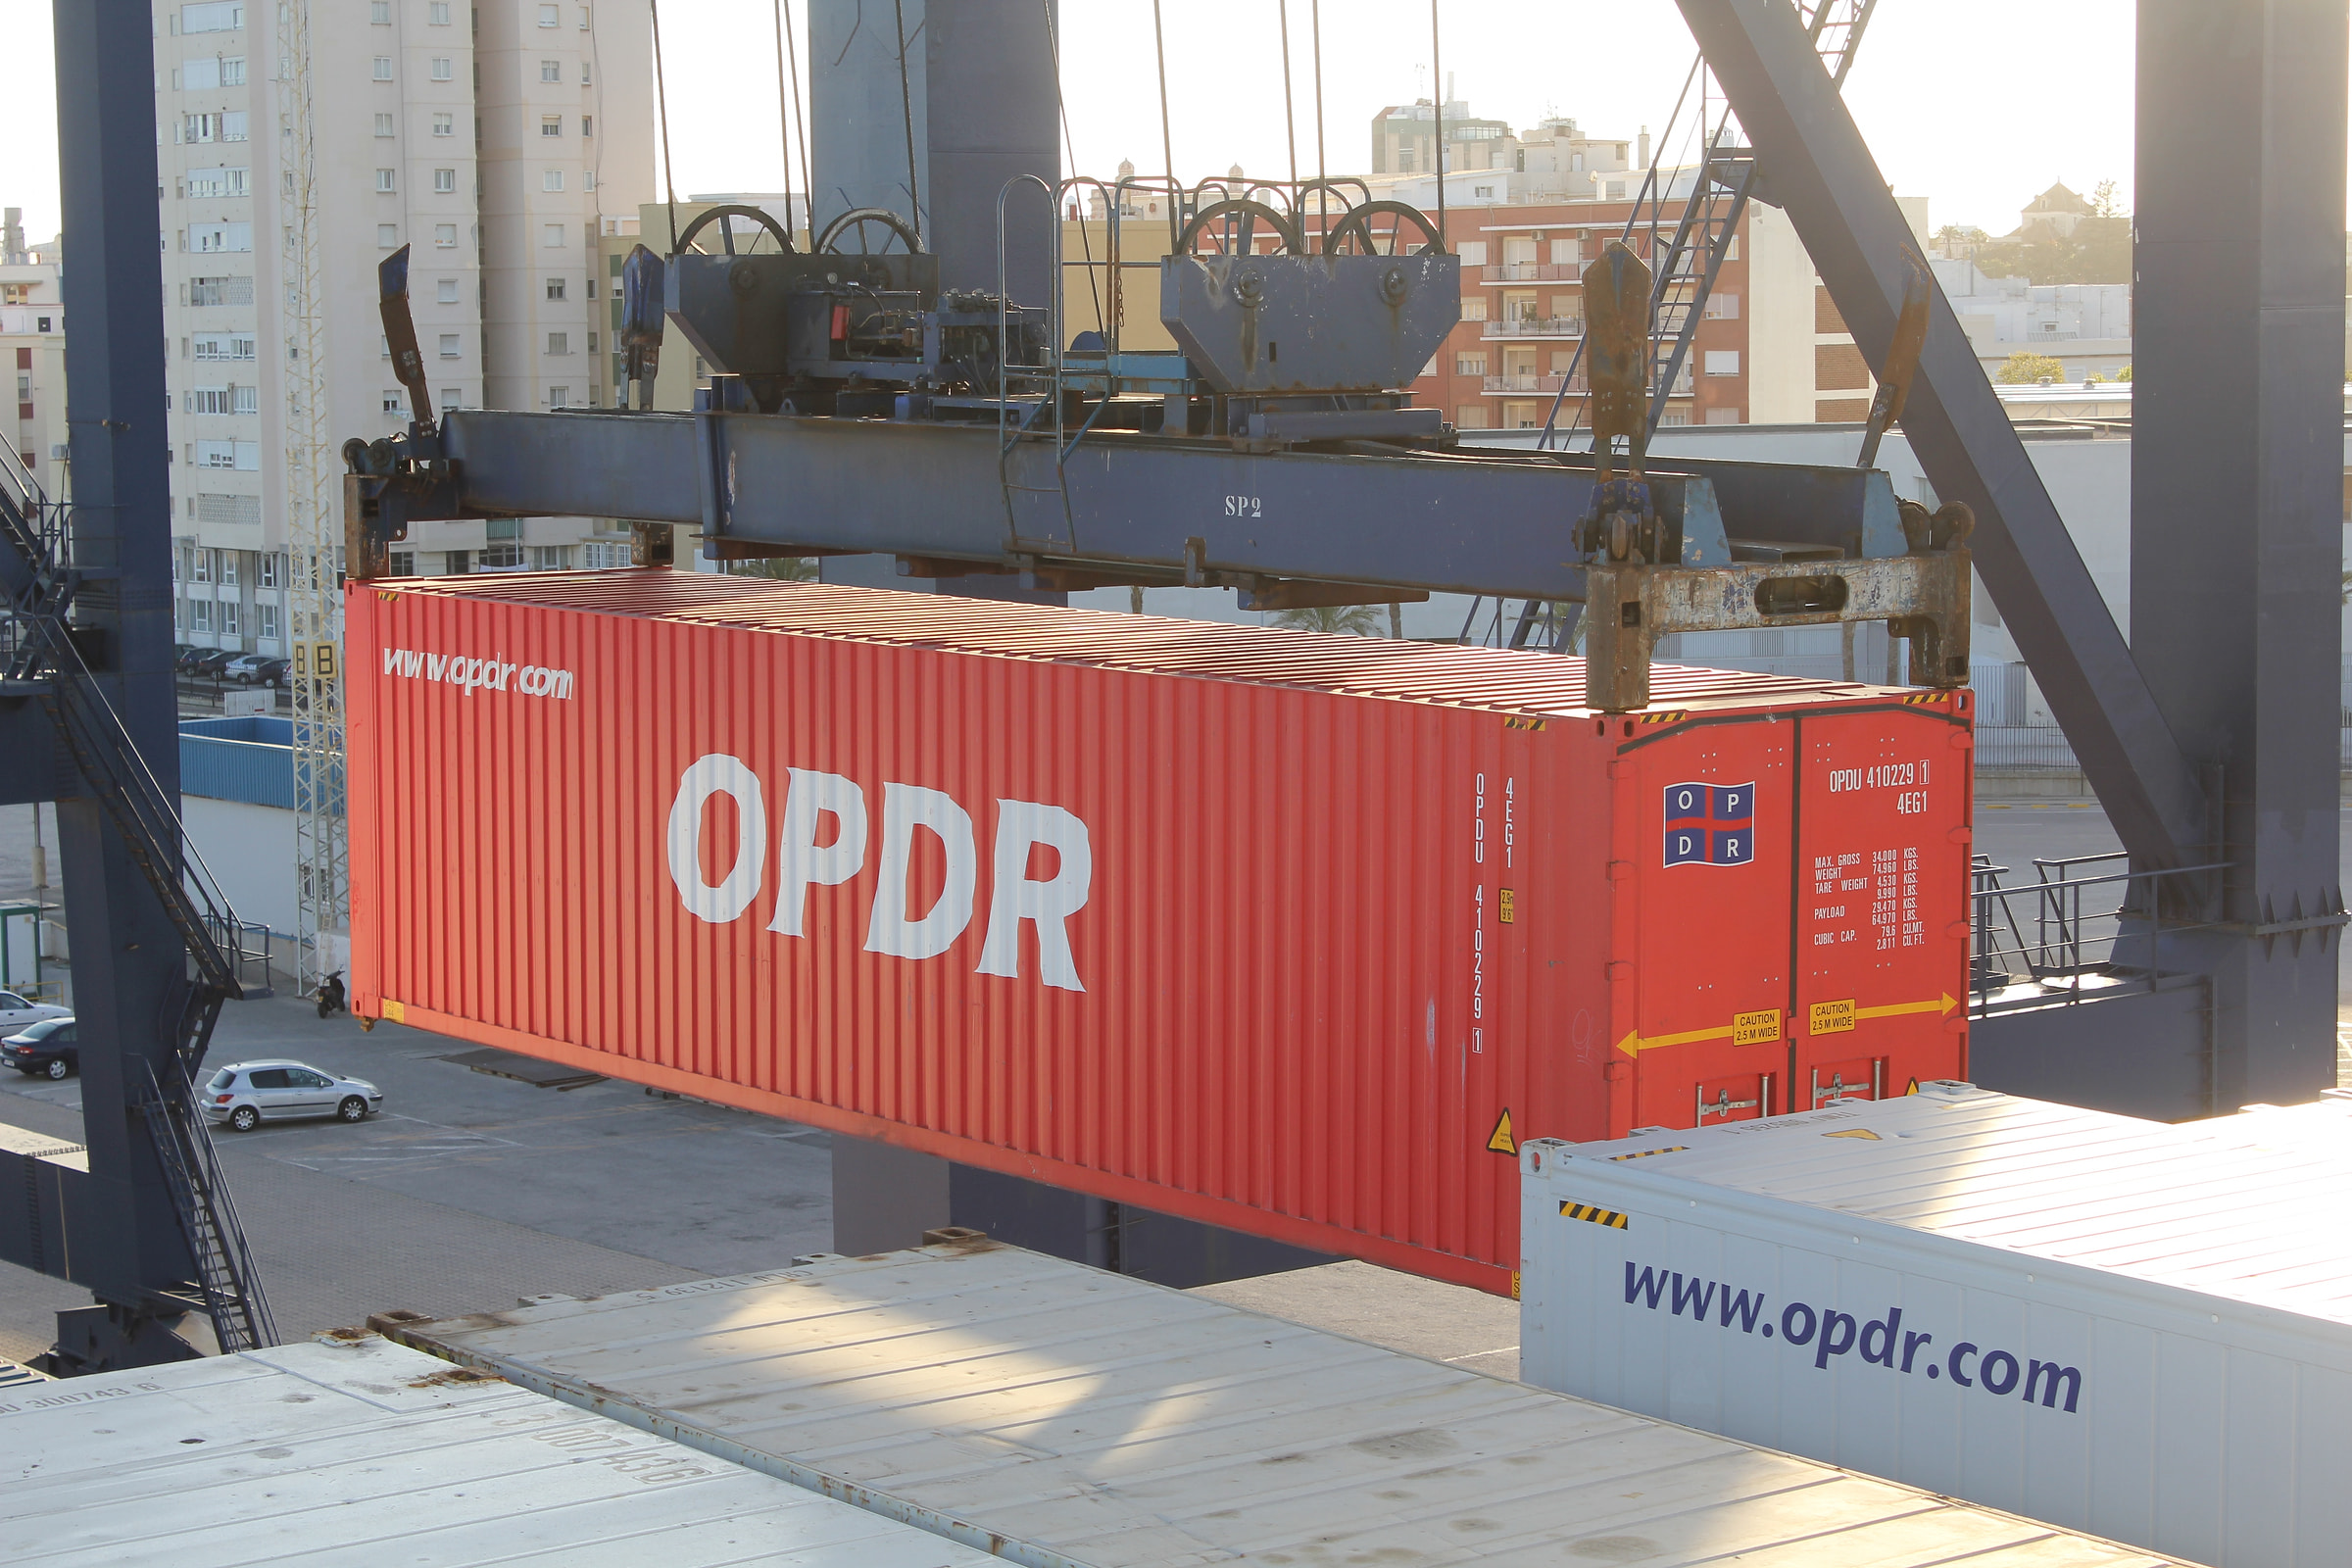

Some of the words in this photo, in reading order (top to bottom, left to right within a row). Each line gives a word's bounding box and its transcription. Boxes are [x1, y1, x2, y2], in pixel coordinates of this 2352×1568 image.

[1225, 495, 1261, 517] SP2
[383, 647, 573, 700] www.opdr.com
[1830, 768, 1862, 793] OPDU
[1866, 762, 1914, 788] 410229
[1896, 790, 1928, 814] 4EG1
[1475, 772, 1485, 863] OPDU
[1505, 777, 1514, 868] 4EG1
[1814, 856, 1835, 869] MAX.
[1838, 853, 1861, 866] GROSS
[1872, 849, 1897, 863] 34.000
[1903, 847, 1919, 859] KGS.
[667, 753, 1092, 993] OPDR
[1815, 866, 1842, 881] WEIGHT
[1872, 861, 1897, 875] 74.960
[1903, 858, 1919, 871] LBS.
[1815, 881, 1833, 895] TARE
[1840, 877, 1868, 892] WEIGHT
[1877, 874, 1897, 888] 4.530
[1903, 872, 1919, 885] KGS.
[1903, 884, 1918, 897] LBS.
[1814, 906, 1845, 920] PAYLOAD
[1872, 900, 1896, 913] 29.470
[1902, 897, 1918, 909] KGS.
[1872, 911, 1896, 926] 64.970
[1902, 909, 1918, 922] LBS.
[1814, 932, 1835, 946] CUBIC
[1840, 929, 1857, 943] CAP.
[1881, 925, 1896, 938] 79.6
[1876, 937, 1895, 951] 2.811
[1474, 884, 1483, 1019] 410229
[1740, 1013, 1775, 1026] CAUTION
[1816, 1004, 1850, 1016] CAUTION
[1737, 1030, 1748, 1041] 2.5
[1749, 1028, 1756, 1039] M
[1758, 1026, 1778, 1038] WIDE
[1812, 1020, 1823, 1031] 2.5
[1824, 1018, 1832, 1029] M
[1833, 1016, 1852, 1027] WIDE
[1624, 1260, 2082, 1413] www.opdr.com
[25, 1388, 131, 1408] 300743
